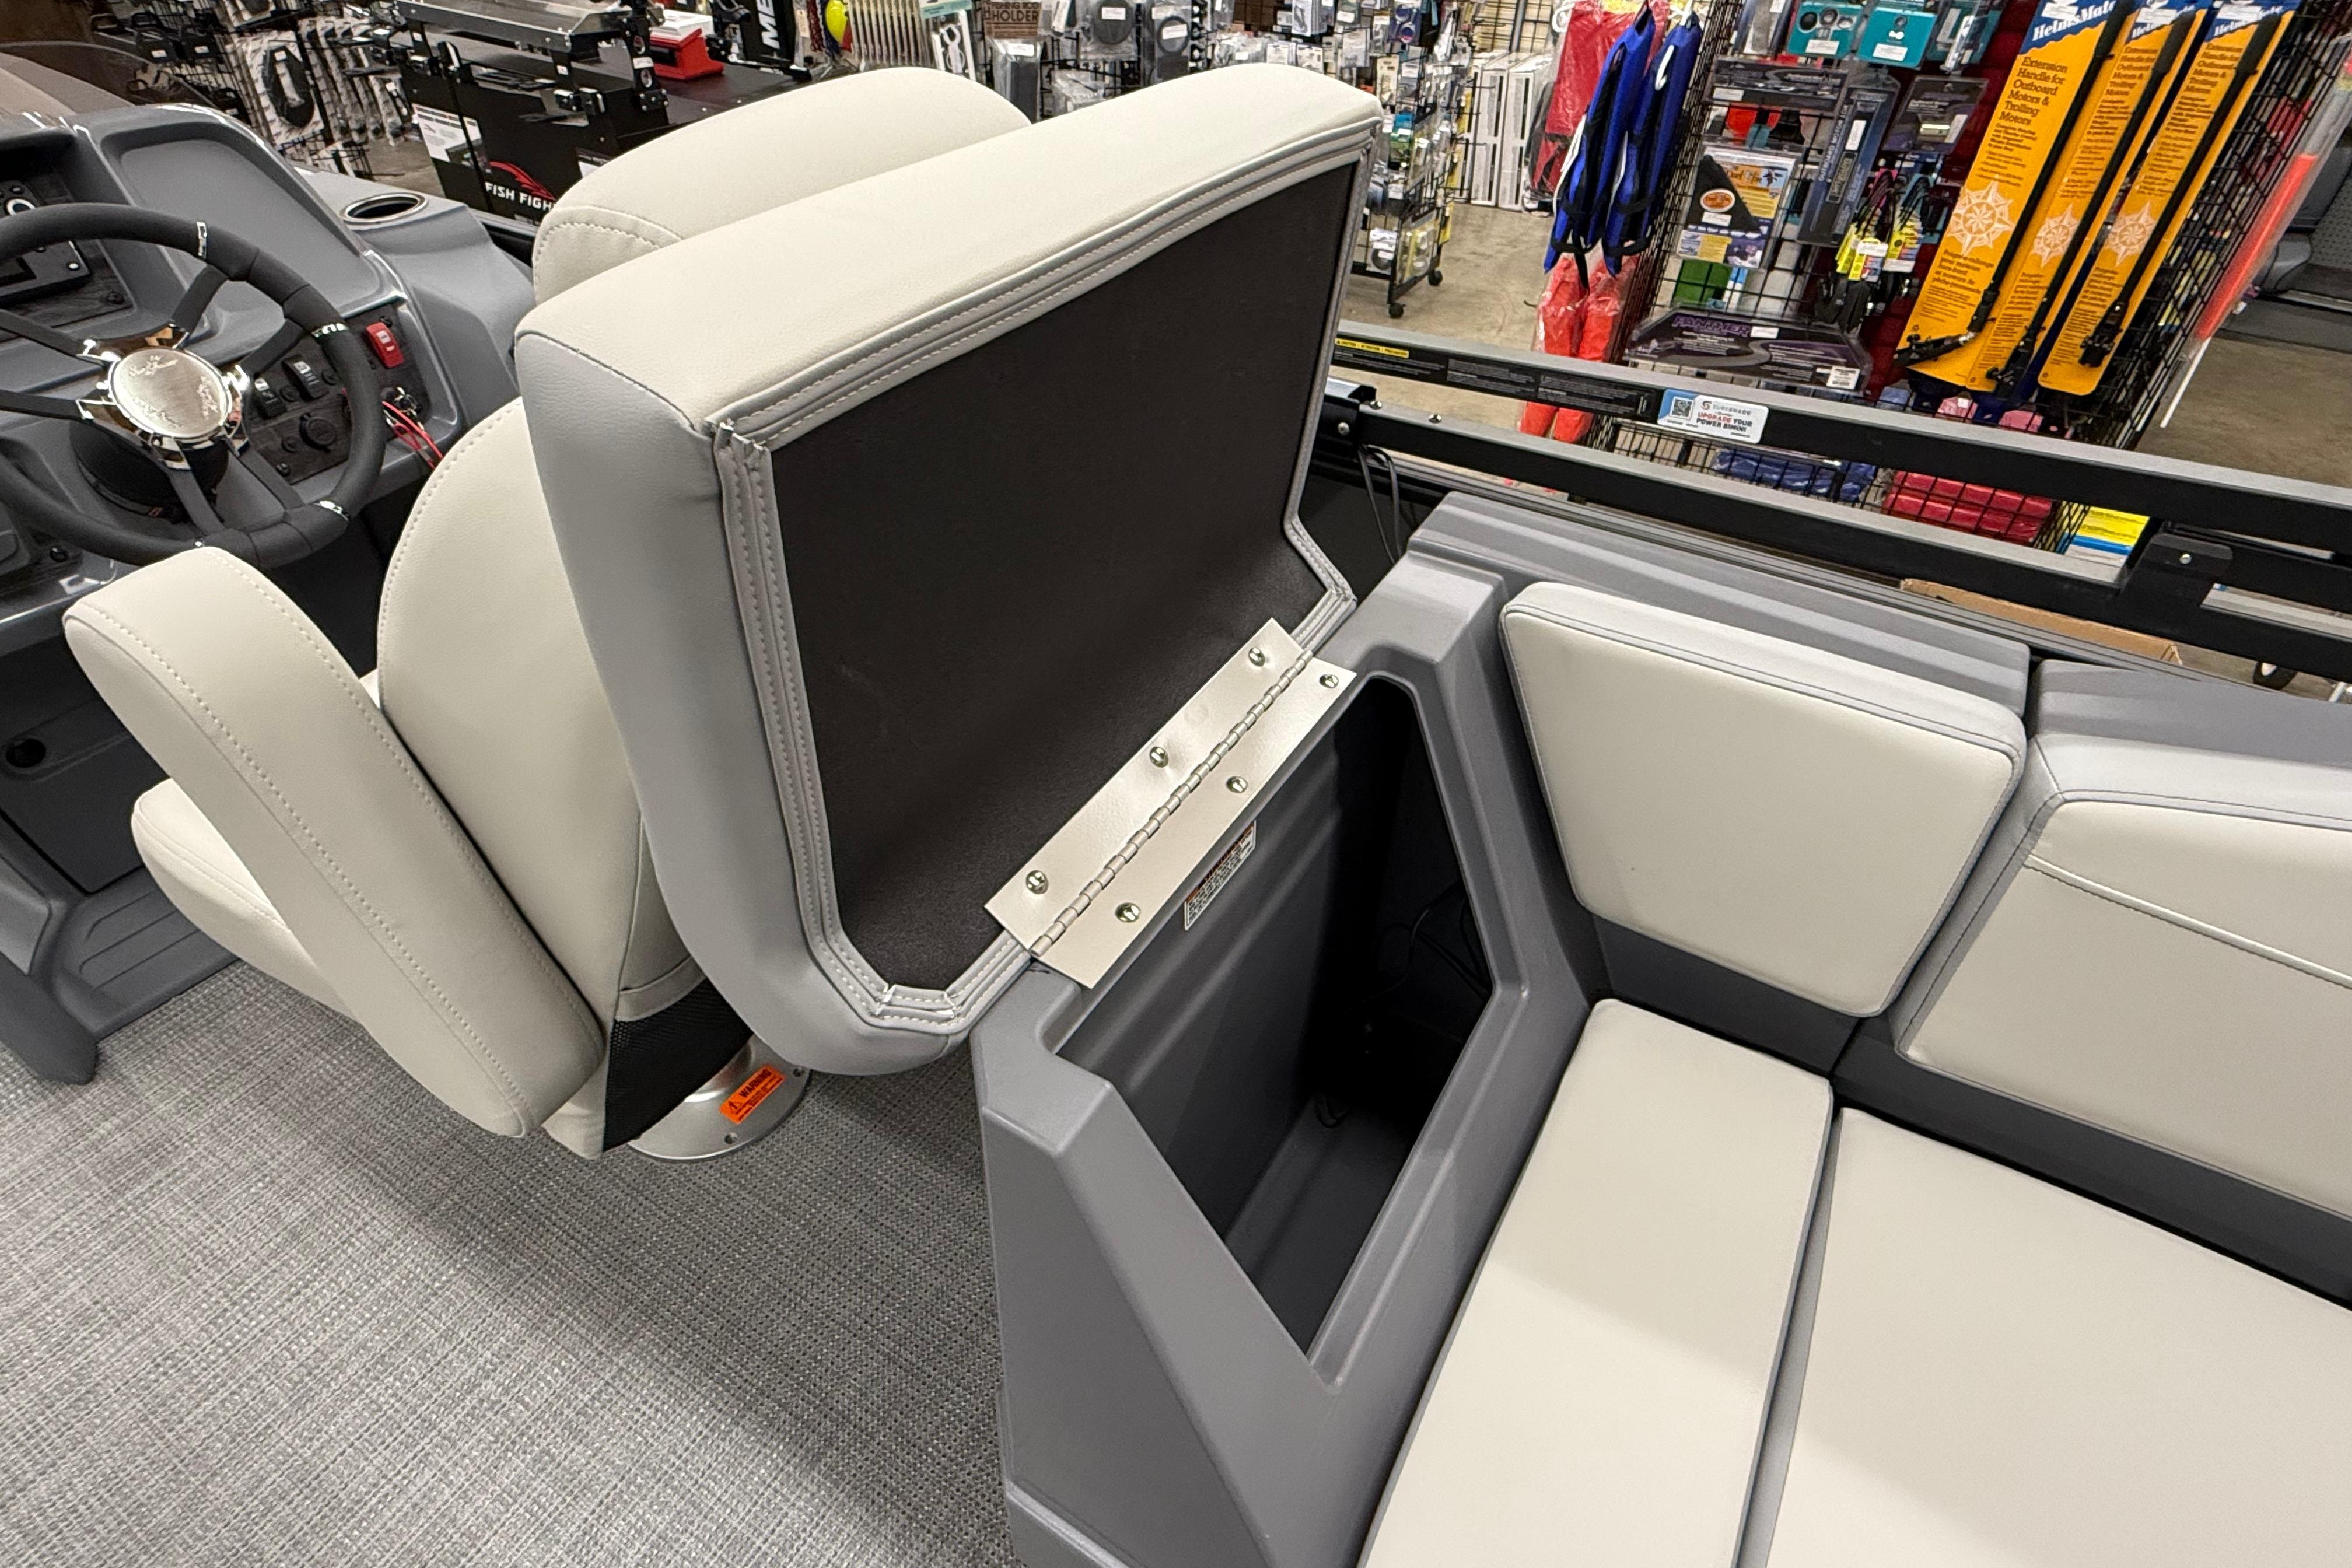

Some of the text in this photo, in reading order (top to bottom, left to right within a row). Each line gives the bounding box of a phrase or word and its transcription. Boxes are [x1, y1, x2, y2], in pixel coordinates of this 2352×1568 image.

[993, 10, 1038, 22] HOLDER
[2021, 57, 2068, 73] Extension
[2017, 67, 2066, 85] Handle for
[2013, 79, 2059, 95] Outboard
[2007, 89, 2041, 104] Motors
[2005, 100, 2040, 117] Trolling
[1999, 111, 2031, 125] Motors
[485, 181, 555, 211] FISH FIGH
[1696, 418, 1722, 428] POWER
[1723, 423, 1747, 432] BIMINI
[1698, 412, 1752, 428] UPGRADE YOUR
[738, 1069, 772, 1098] WARNING
